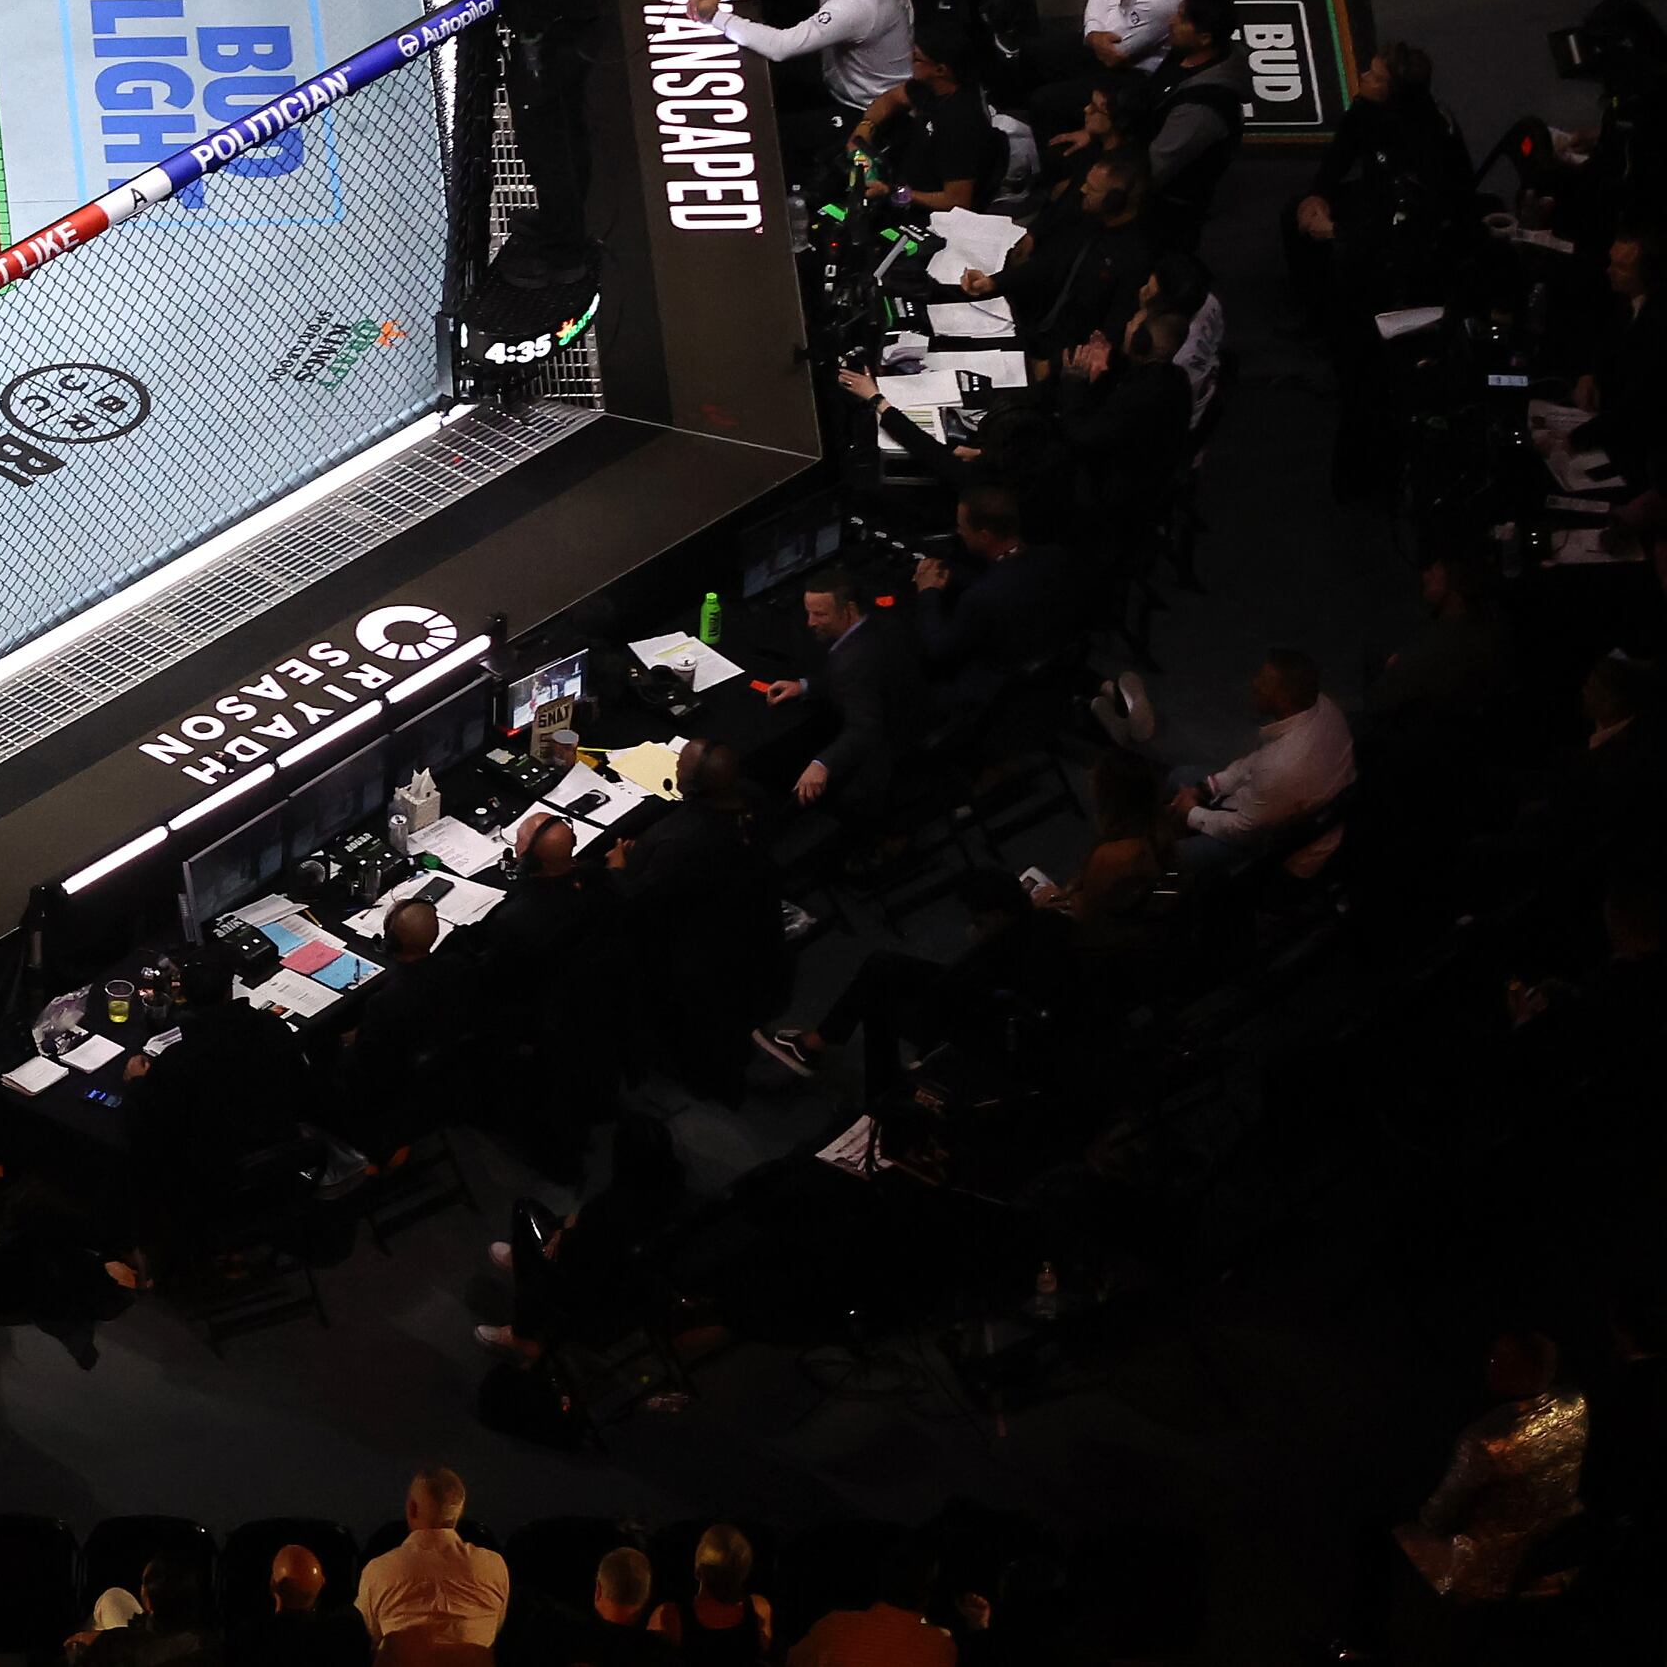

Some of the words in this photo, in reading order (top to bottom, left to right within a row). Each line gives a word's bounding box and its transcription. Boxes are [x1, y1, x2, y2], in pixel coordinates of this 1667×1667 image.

[1242, 22, 1304, 103] BUD
[11, 222, 79, 273] LIKE
[131, 187, 148, 211] A
[484, 333, 552, 365] 4:35
[138, 641, 352, 765] SEASON
[181, 663, 394, 785] RIYADH
